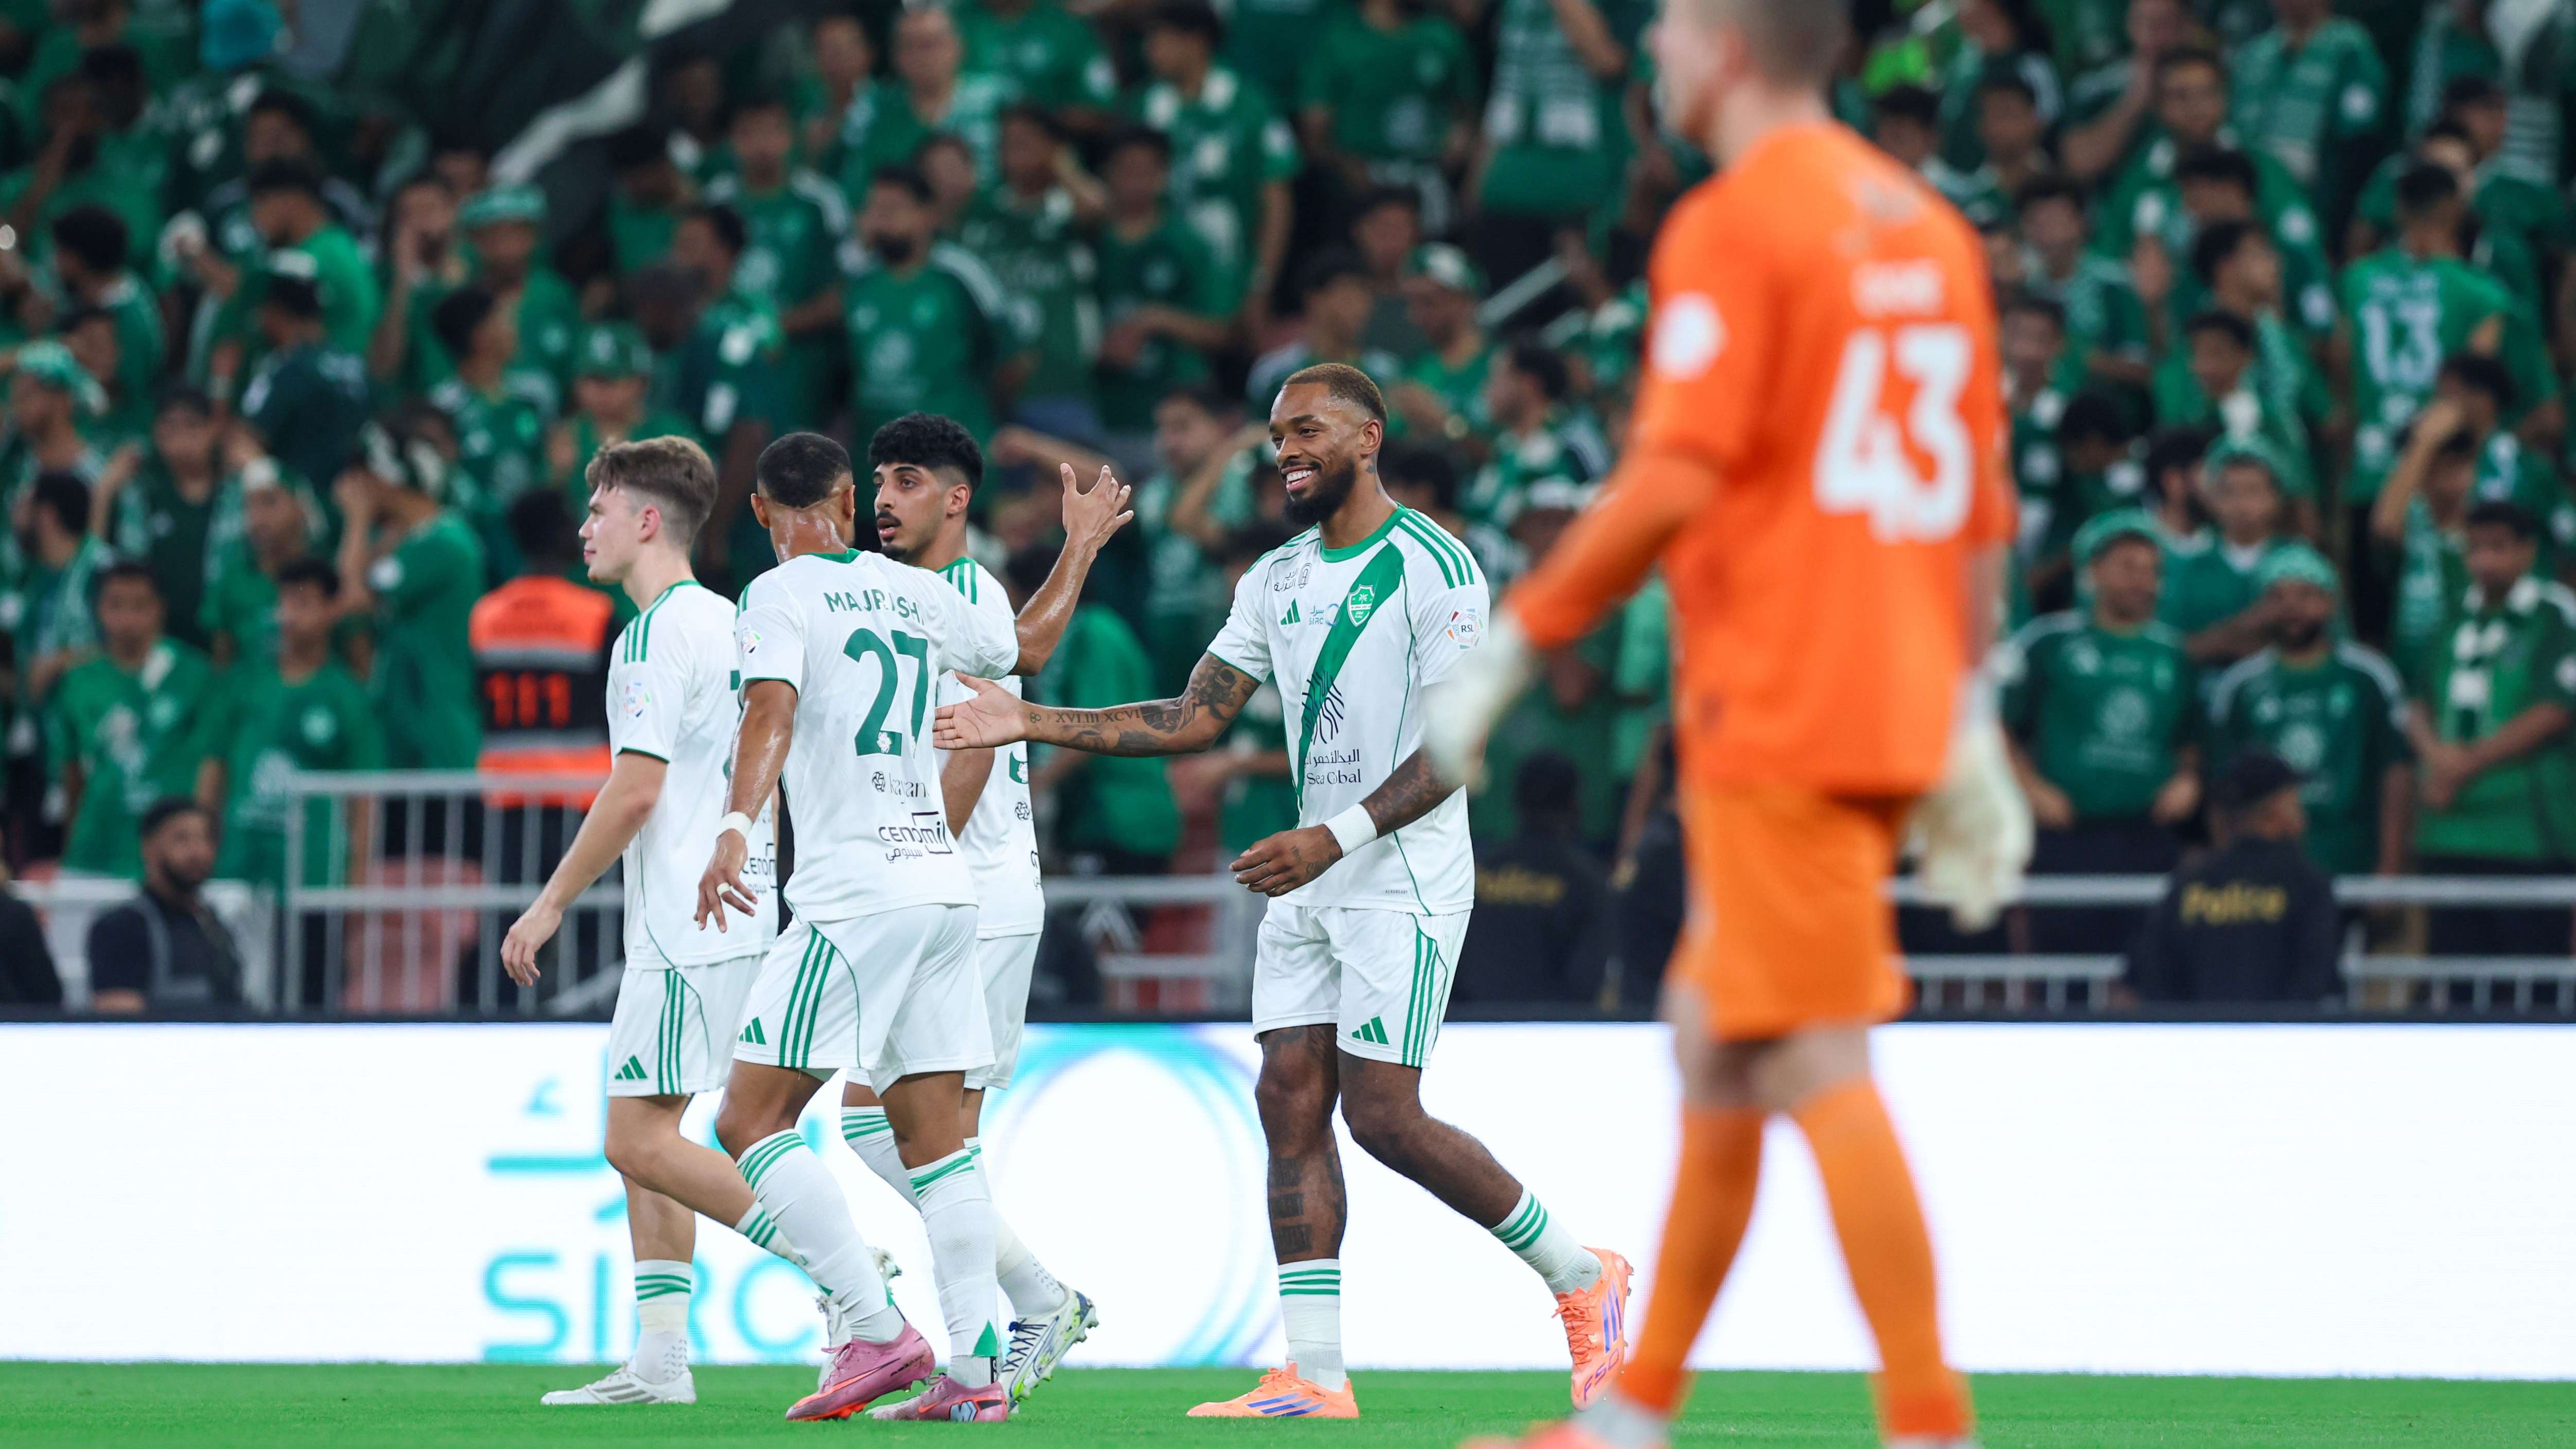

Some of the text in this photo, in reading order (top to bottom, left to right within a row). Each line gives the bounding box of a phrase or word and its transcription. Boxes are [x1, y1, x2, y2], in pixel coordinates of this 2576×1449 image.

[1814, 323, 1973, 544] 43
[1461, 624, 1474, 633] RSL
[844, 627, 928, 758] 27
[1307, 773, 1325, 785] Sea
